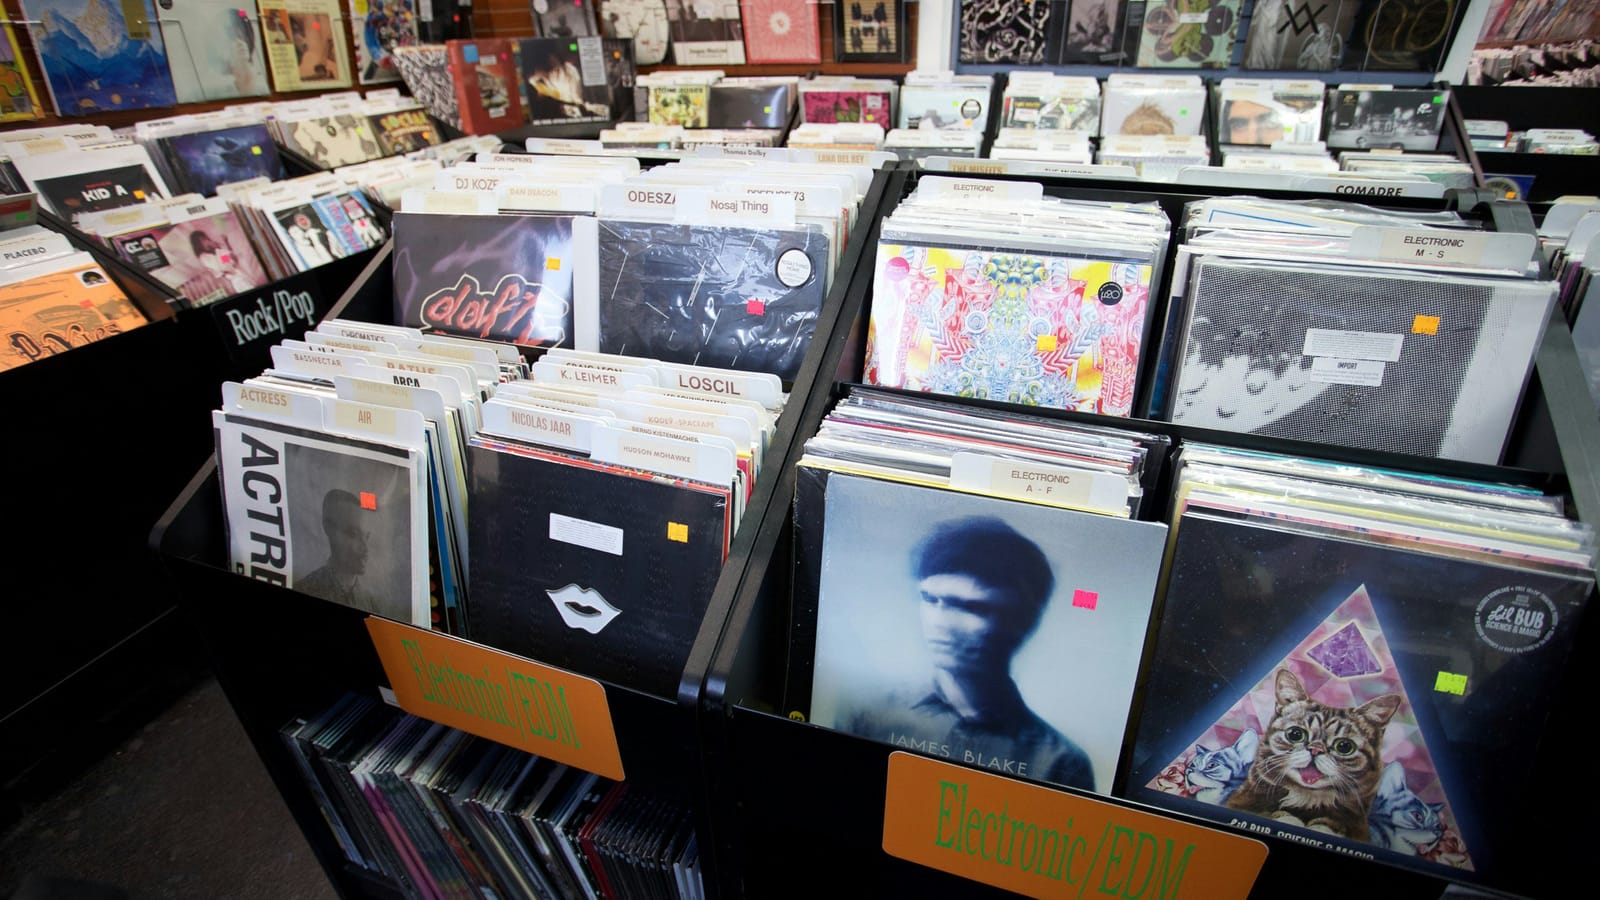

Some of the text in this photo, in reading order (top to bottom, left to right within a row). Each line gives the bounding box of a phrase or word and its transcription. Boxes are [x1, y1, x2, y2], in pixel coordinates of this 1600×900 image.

[723, 148, 746, 156] Thomas
[817, 153, 835, 163] LANA
[837, 153, 849, 163] DEL
[456, 177, 469, 190] DJ
[953, 183, 995, 192] ELECTRONIC
[81, 188, 111, 202] KID
[115, 184, 128, 197] A
[794, 191, 805, 202] 73
[710, 200, 769, 214] Nosaj Thing
[1403, 235, 1464, 248] ELECTRONIC
[3, 247, 46, 261] PLACEBO
[1415, 249, 1424, 257] M
[1437, 250, 1445, 258] S
[226, 290, 316, 346] Rock/Pop
[294, 353, 343, 367] BASSNECTAR
[1337, 361, 1358, 370] IMPORT
[560, 370, 617, 385] K. LEIMER
[678, 374, 741, 395] LOSCIL
[240, 388, 288, 407] ACTRESS
[358, 409, 372, 425] AIR
[511, 411, 572, 437] NICOLAS JAAR
[623, 445, 691, 463] HUDSON MOHAWKE
[1011, 470, 1070, 484] ELECTRONIC
[1025, 484, 1033, 492] A
[1046, 486, 1053, 494] F
[1487, 604, 1515, 623] Lil
[1514, 607, 1545, 629] BUB
[1485, 620, 1513, 633] SCIENCE
[400, 639, 583, 750] Electronic/EDM
[889, 731, 1028, 777] JAMES BLAKE
[935, 779, 1198, 900] Electronic/EDM
